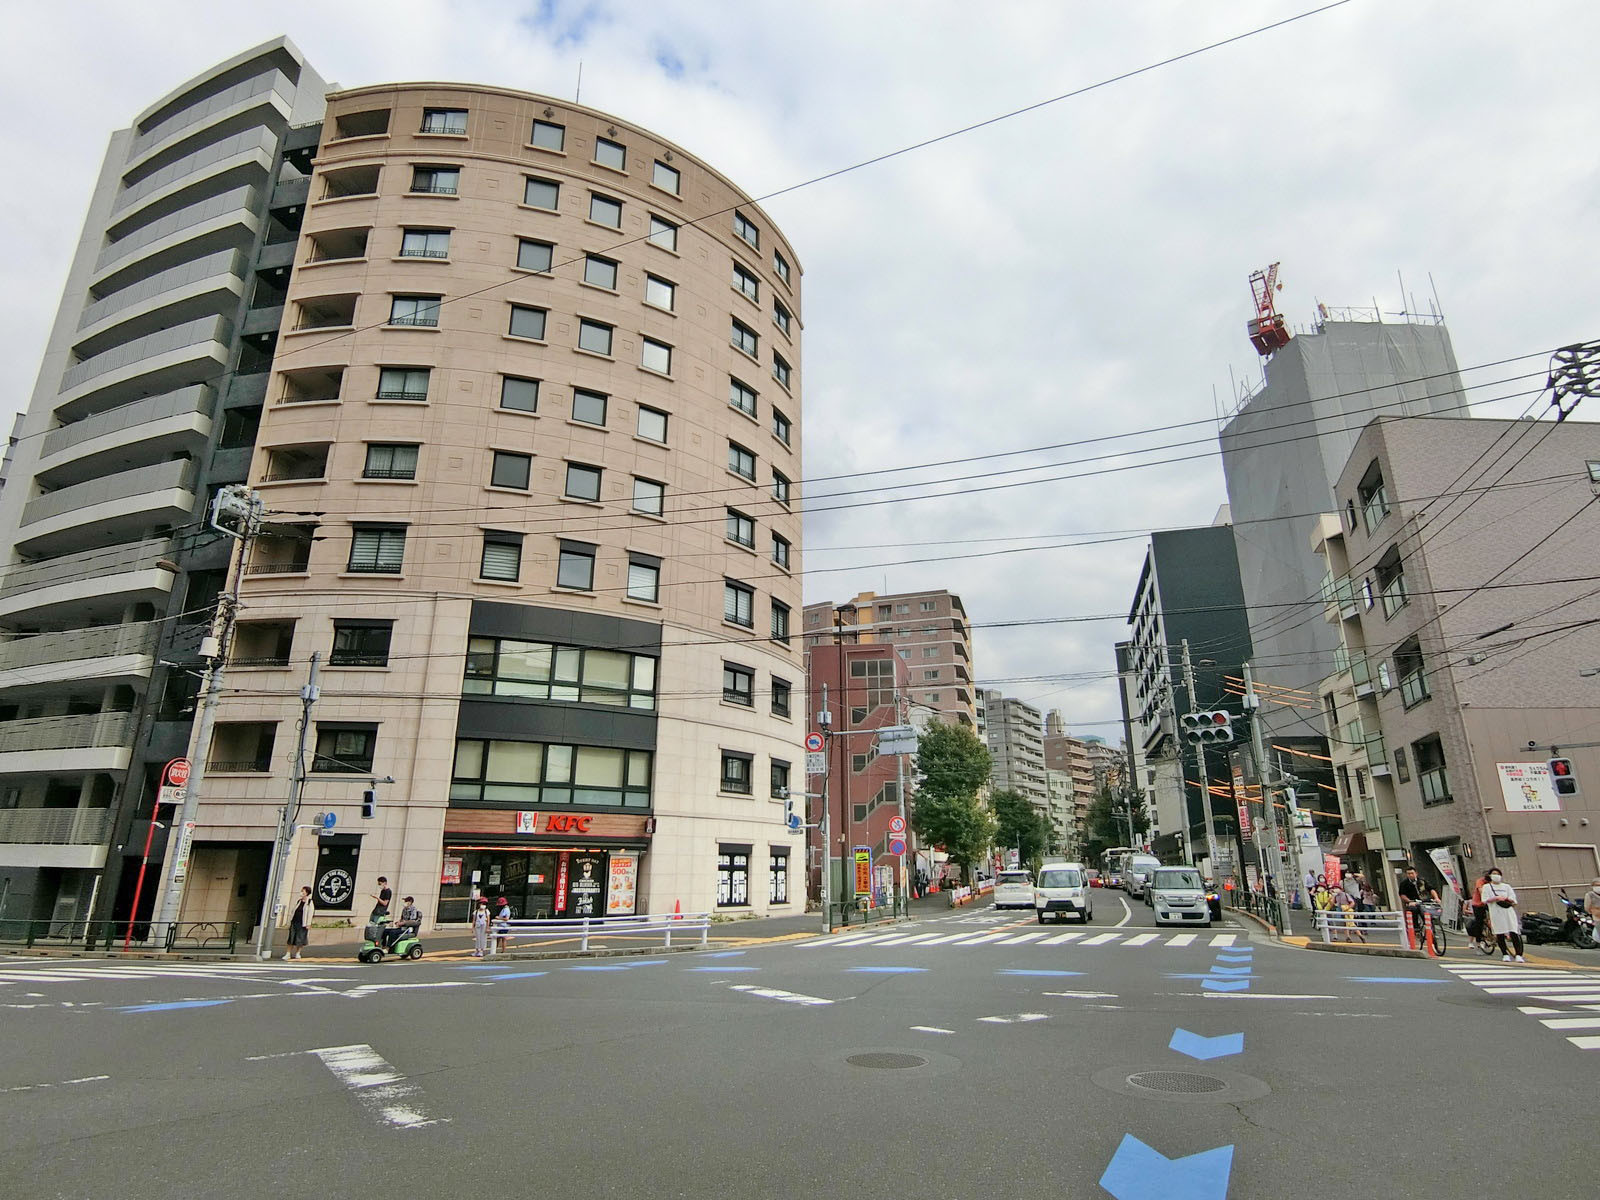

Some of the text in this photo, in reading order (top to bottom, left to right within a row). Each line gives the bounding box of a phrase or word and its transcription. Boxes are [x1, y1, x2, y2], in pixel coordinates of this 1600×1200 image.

[546, 815, 593, 832] KFC
[557, 861, 567, 909] お持ち帰り専門店
